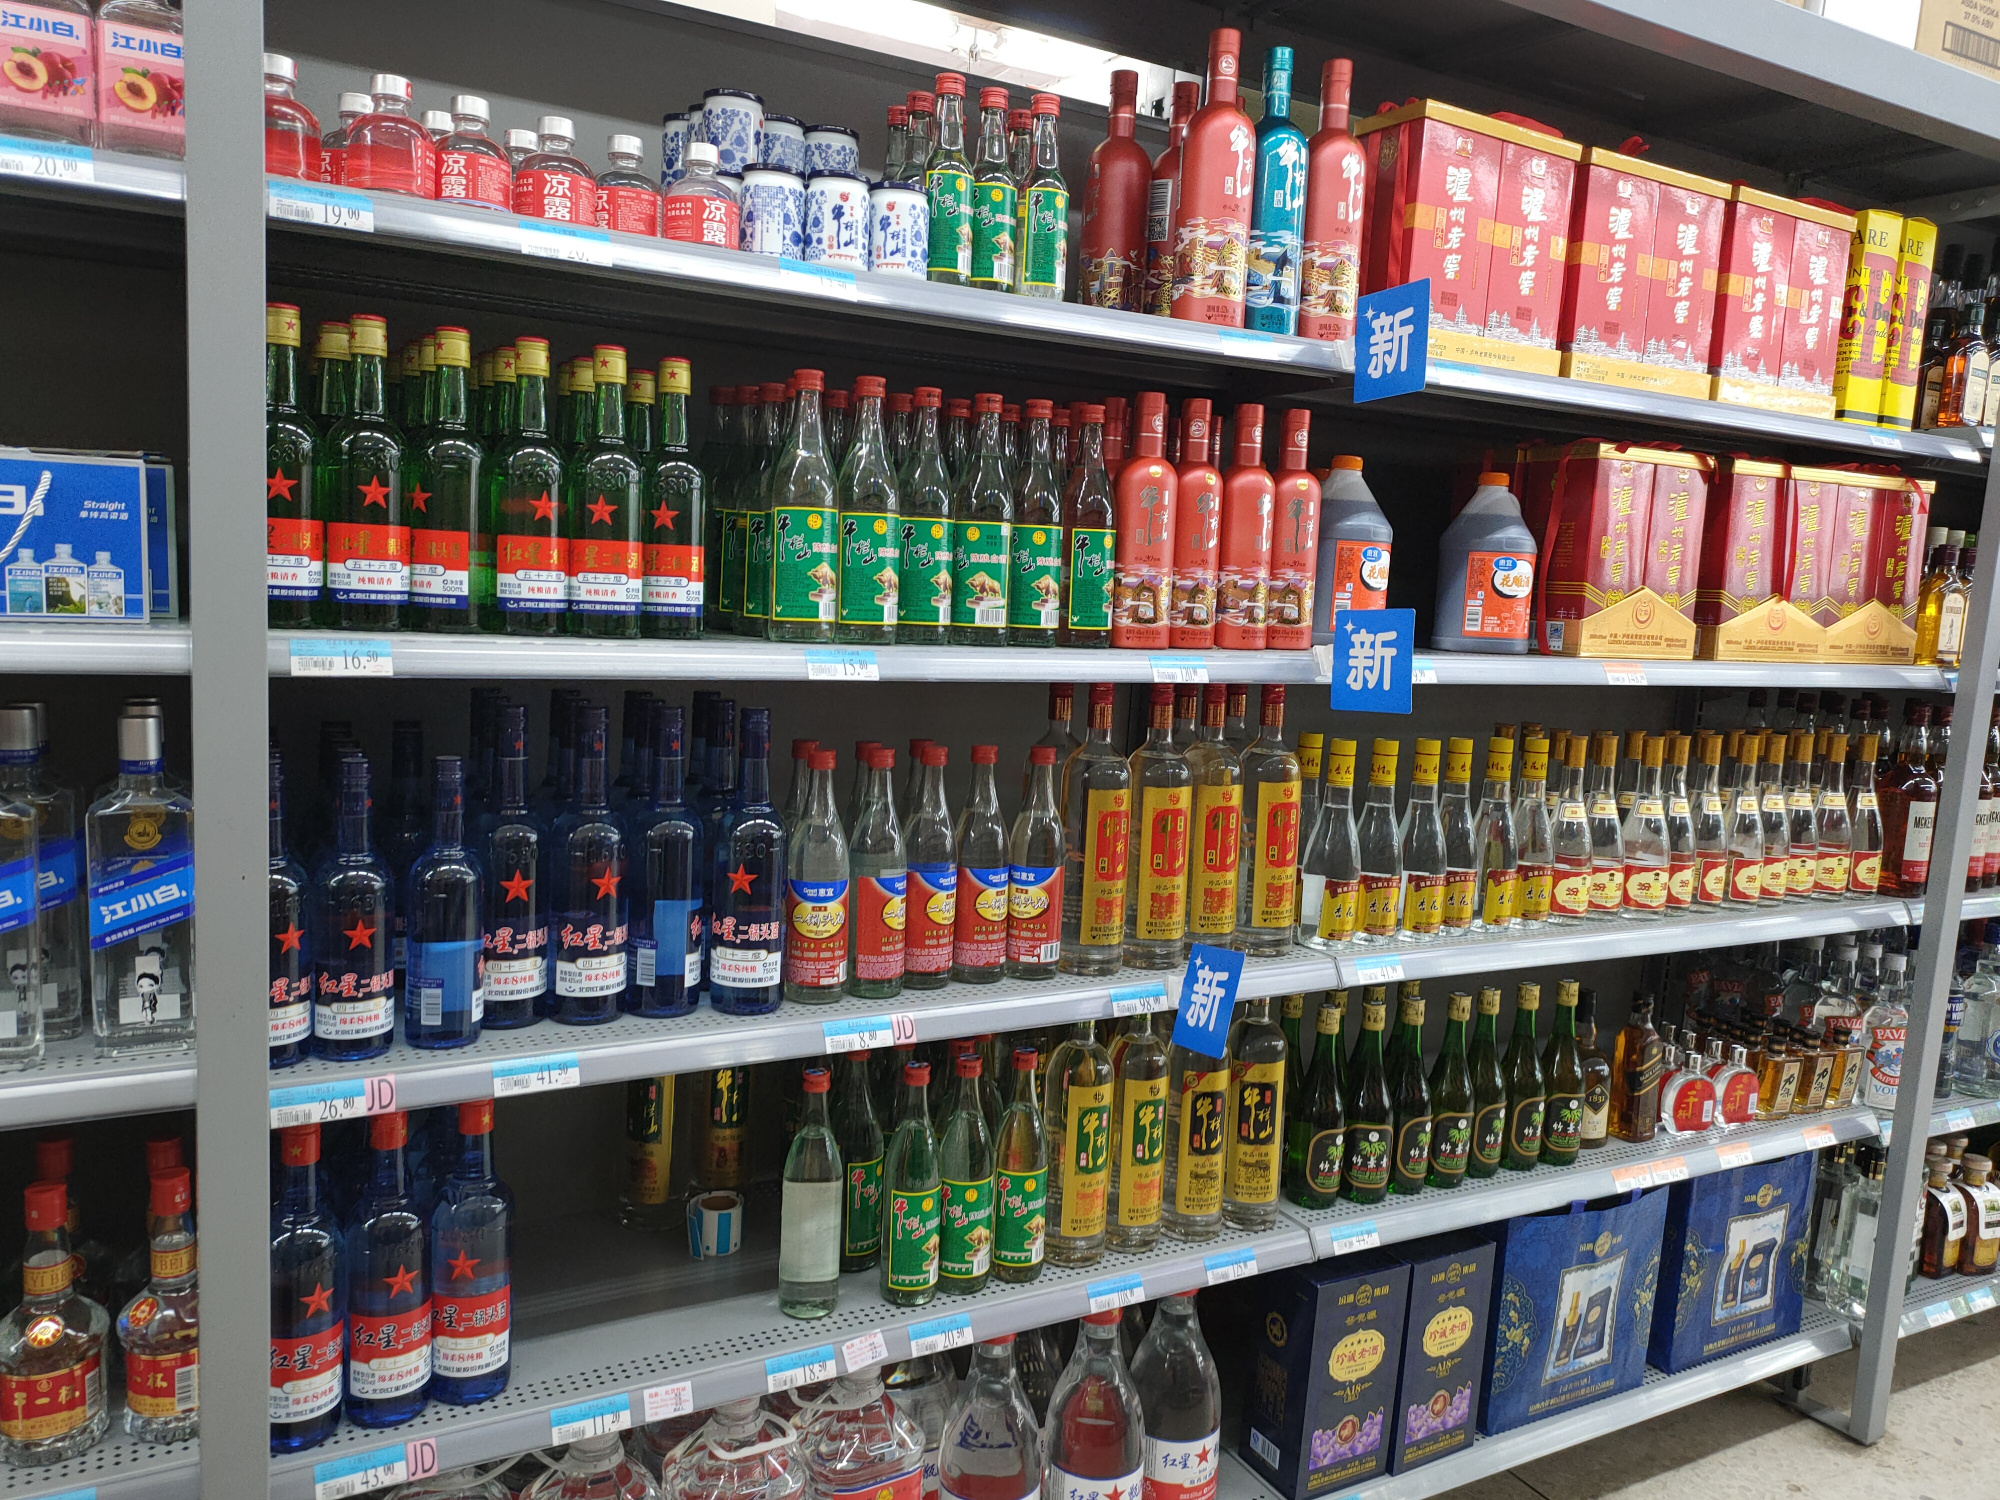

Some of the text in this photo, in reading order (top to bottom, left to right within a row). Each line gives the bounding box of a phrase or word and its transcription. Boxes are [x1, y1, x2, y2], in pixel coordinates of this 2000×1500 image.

[1978, 4, 1999, 18] VODKA
[32, 155, 77, 178] 20.00
[441, 153, 467, 198] 凉露
[543, 172, 572, 221] 凉露
[323, 201, 360, 226] 19.00
[702, 198, 727, 245] 凉露
[1443, 166, 1473, 280] 泸州老窖
[1519, 185, 1547, 296] 泸州老窖
[1605, 206, 1633, 311] 泸州老窖
[1674, 223, 1700, 324] 泸州老窖
[1749, 240, 1773, 340] 泸州老窖
[1864, 285, 1881, 297] THE
[1805, 255, 1829, 351] 泸州老窖
[1859, 304, 1867, 316] &
[1367, 306, 1414, 380] 新
[79, 510, 129, 521] 单纯高粱酒
[83, 500, 126, 511] Straight
[777, 514, 811, 561] 牛栏山
[843, 519, 877, 566] 牛栏山
[1610, 485, 1636, 584] 泸州老窖
[1666, 491, 1692, 587] 泸州老窖
[1744, 499, 1769, 590] 泸州老窖
[900, 523, 934, 569] 牛栏山
[1075, 535, 1106, 577] 牛栏山
[1797, 505, 1822, 594] 泸州老窖
[1847, 509, 1869, 598] 泸州老窖
[352, 561, 398, 571] 五十六度
[970, 554, 1007, 565] 陈酿白酒
[1892, 514, 1913, 600] 泸州老窖
[357, 575, 393, 586] 纯粮清香
[522, 572, 562, 580] 五十六度
[582, 574, 626, 583] 五十六度
[645, 577, 683, 586] 五十六度
[1500, 574, 1530, 588] 花雕酒
[442, 585, 465, 593] 500mL
[527, 585, 558, 595] 纯粮清香
[585, 588, 617, 597] 纯粮清香
[648, 590, 678, 599] 纯粮清香
[343, 649, 379, 670] 16.50
[842, 658, 867, 676] 15.80
[1346, 628, 1398, 692] 新
[1211, 811, 1236, 868] 牛栏山
[1155, 854, 1162, 868] 白酒
[1207, 850, 1214, 864] 白酒
[1269, 846, 1276, 860] 白酒
[1100, 858, 1107, 872] 白酒
[1021, 871, 1035, 882] 惠宜
[818, 887, 834, 897] 惠宜
[793, 909, 845, 927] 二锅头酒
[582, 955, 623, 967] 四十三度
[719, 949, 761, 960] 四十三度
[491, 959, 538, 972] 四十三度
[720, 962, 757, 973] 绵柔8纯粮
[493, 974, 535, 986] 绵柔8纯粮
[585, 971, 621, 982] 绵柔8纯粮
[337, 1001, 383, 1012] 四十三度
[1139, 995, 1161, 1012] 98.00
[1186, 967, 1229, 1032] 新
[271, 1016, 308, 1031] 绵柔8纯粮
[339, 1012, 380, 1026] 绵柔8纯粮
[896, 1015, 914, 1041] JD
[859, 1030, 877, 1048] 8.80
[536, 1063, 568, 1085] 41.50
[367, 1078, 395, 1112] JD
[1589, 1093, 1606, 1104] 1891
[319, 1096, 354, 1121] 26.80
[1244, 1087, 1273, 1140] 牛栏山
[1138, 1105, 1163, 1160] 牛栏山
[1196, 1096, 1222, 1150] 牛栏山
[1082, 1112, 1108, 1169] 牛栏山
[998, 1176, 1028, 1218] 牛栏山
[894, 1197, 926, 1239] 牛栏山
[160, 1257, 184, 1273] BEI
[941, 1327, 965, 1348] 20.50
[1428, 1320, 1468, 1342] 珍藏老酒
[442, 1337, 489, 1348] 五十三度
[377, 1350, 423, 1368] 五十三度
[442, 1350, 483, 1361] 绵柔8纯粮
[1335, 1344, 1380, 1366] 珍藏老酒
[290, 1369, 337, 1392] 五十三度
[378, 1365, 420, 1383] 绵柔8纯粮
[802, 1360, 827, 1383] 18.50
[291, 1385, 334, 1406] 绵柔8纯粮
[593, 1410, 620, 1434] 11.20
[411, 1443, 435, 1476] JD
[1161, 1452, 1191, 1470] 红星
[361, 1463, 394, 1489] 43.00
